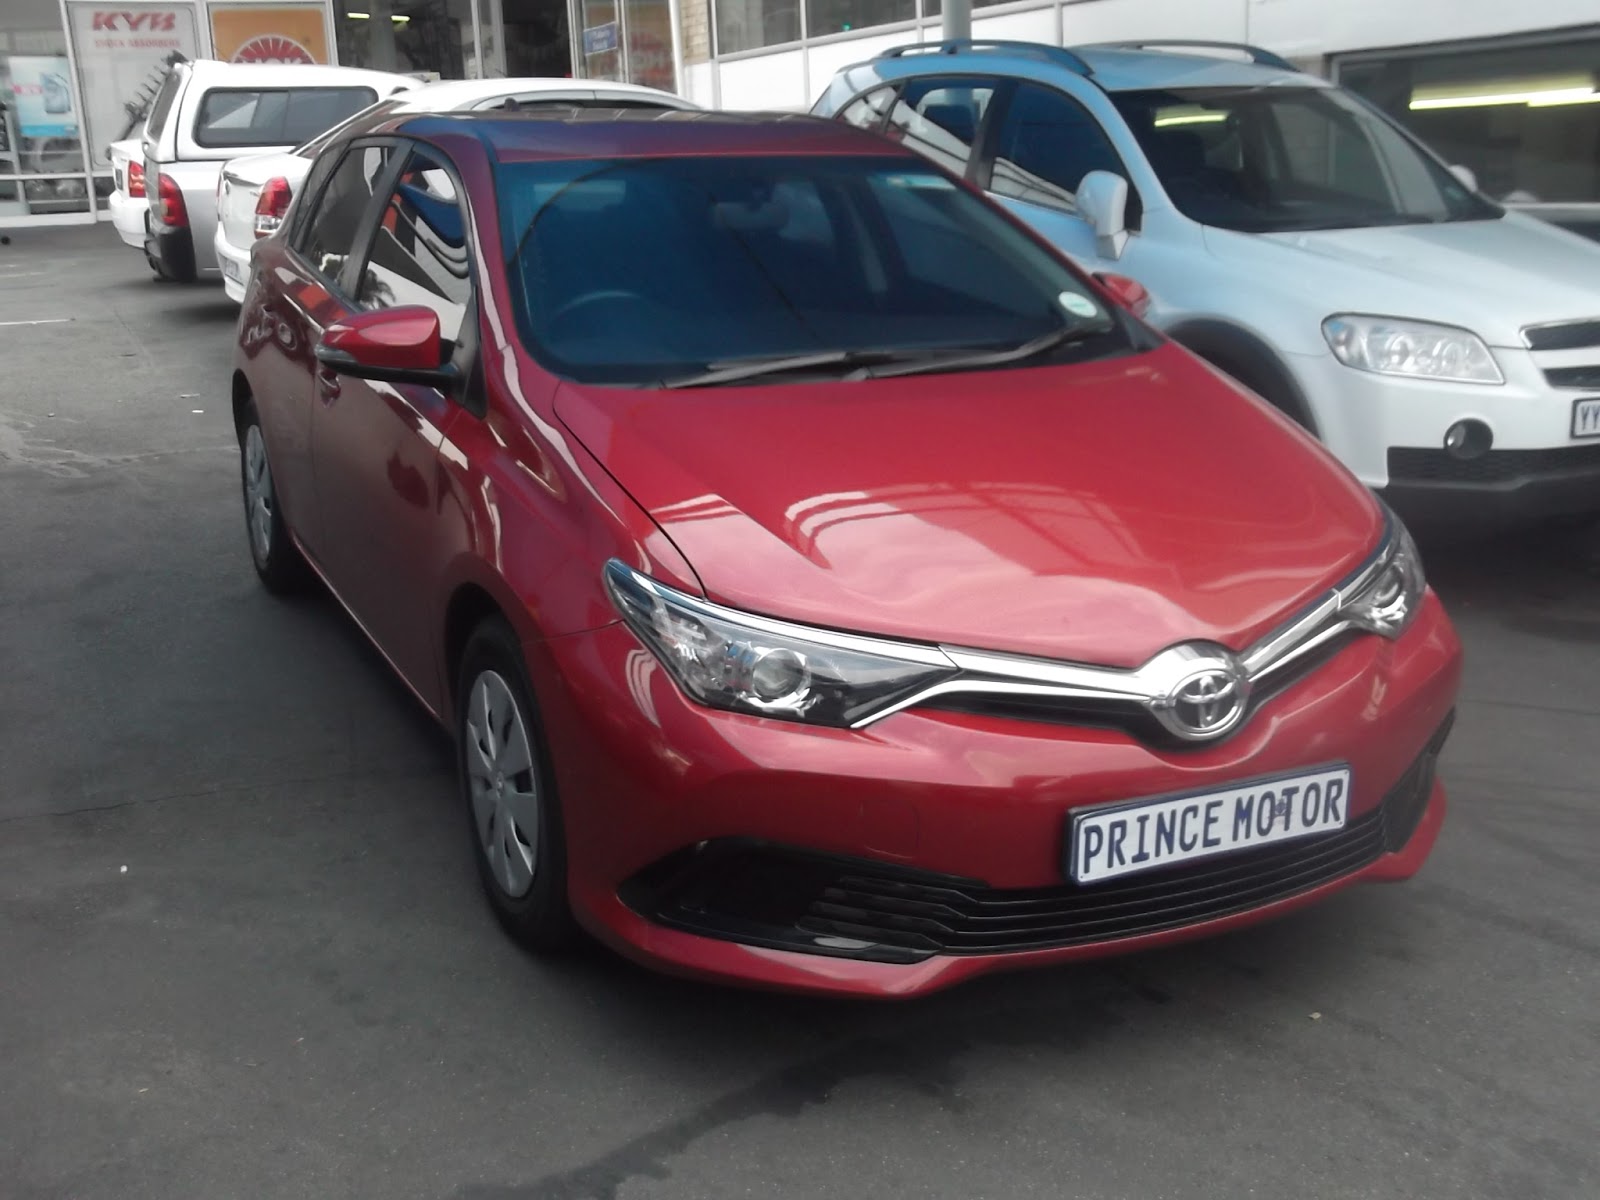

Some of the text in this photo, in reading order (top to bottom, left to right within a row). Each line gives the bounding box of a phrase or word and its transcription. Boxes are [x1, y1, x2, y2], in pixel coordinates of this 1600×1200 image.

[92, 11, 176, 32] KYB
[1083, 778, 1344, 874] PRINCE MOTOR
